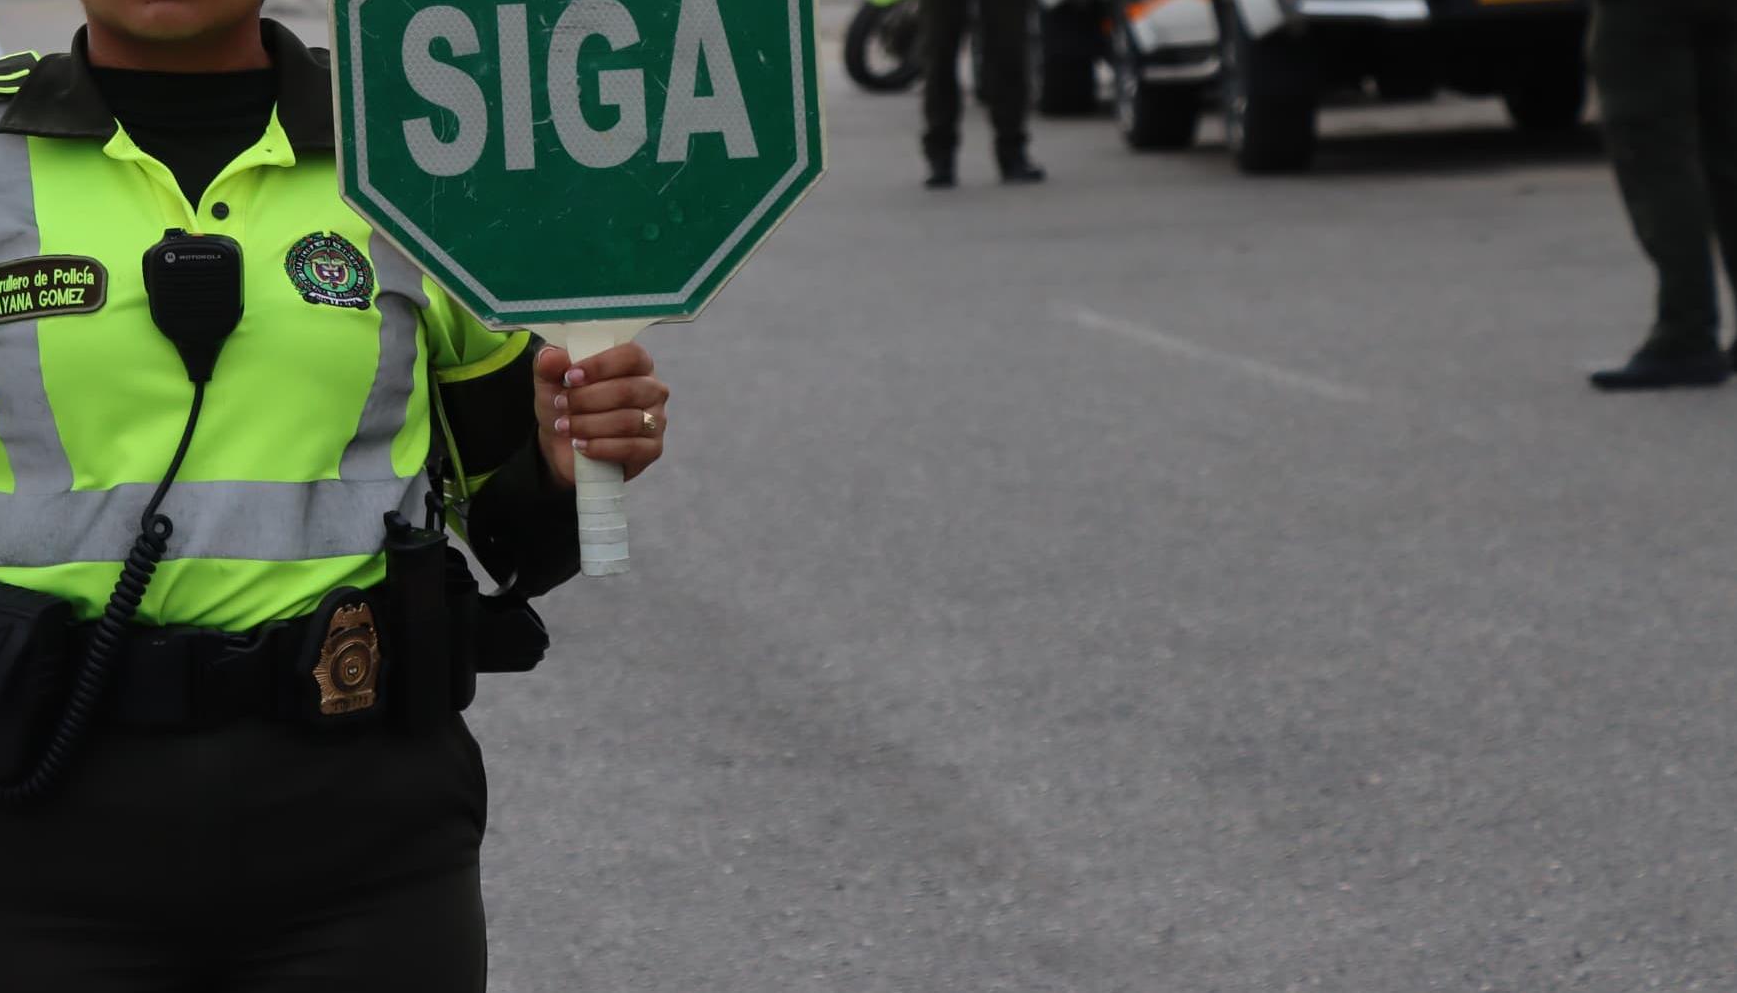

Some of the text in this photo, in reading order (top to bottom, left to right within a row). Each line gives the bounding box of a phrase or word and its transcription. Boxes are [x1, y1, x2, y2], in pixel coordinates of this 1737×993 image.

[34, 269, 48, 287] de
[54, 265, 95, 286] Policía
[38, 288, 84, 308] GOMEZ
